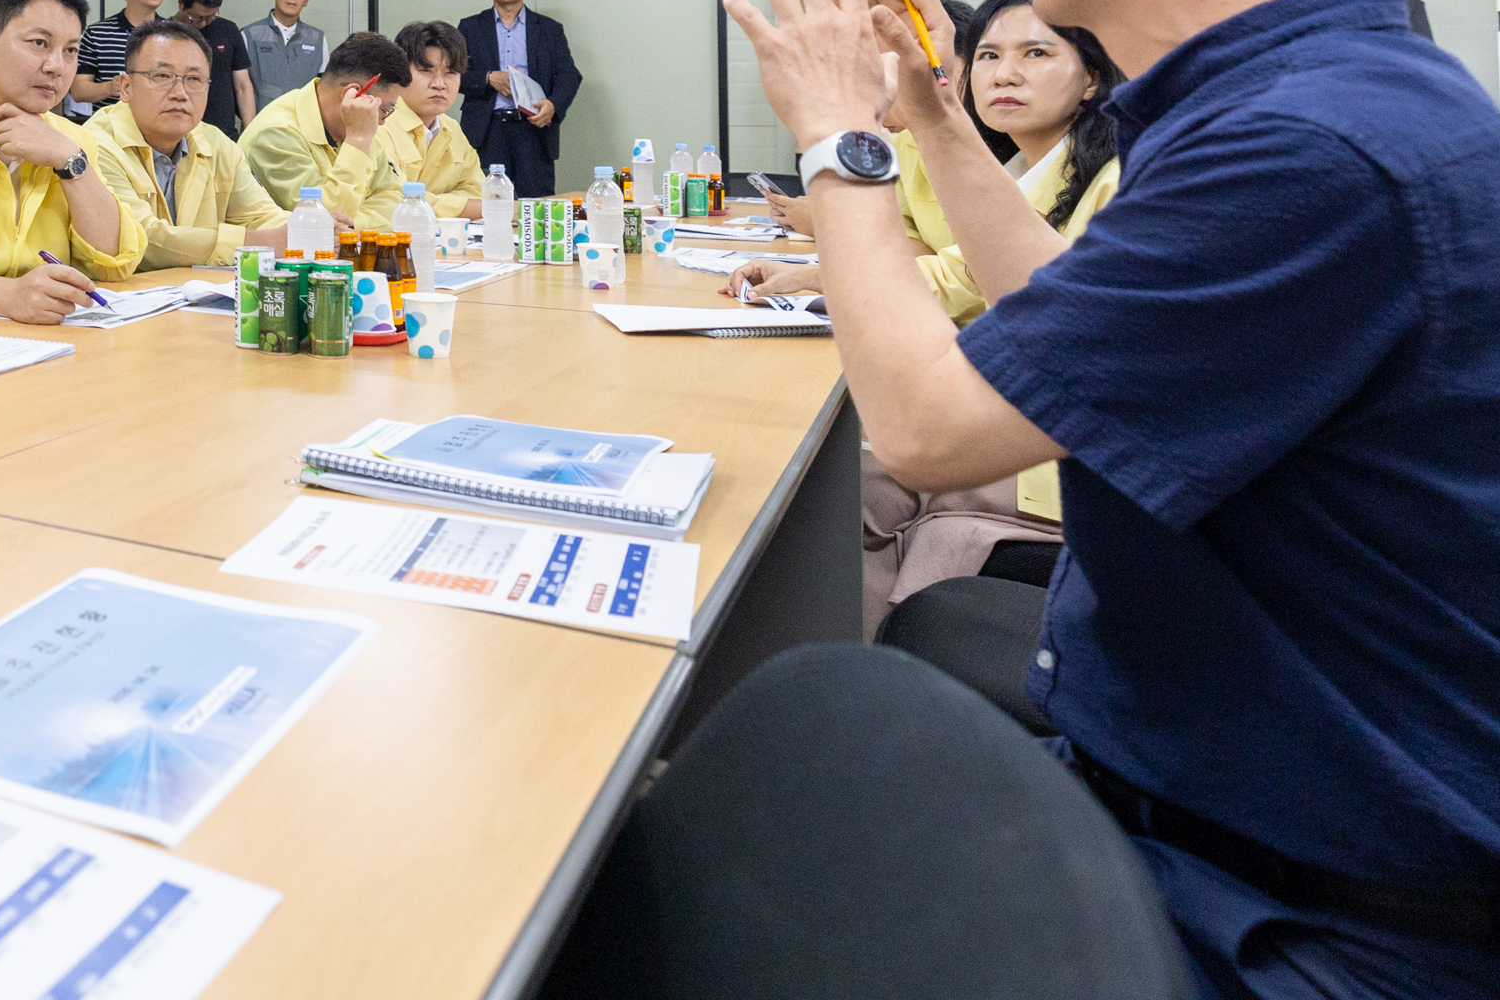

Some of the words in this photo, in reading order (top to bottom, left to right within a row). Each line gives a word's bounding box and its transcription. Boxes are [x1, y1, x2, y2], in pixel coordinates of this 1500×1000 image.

[523, 204, 531, 253] DEMISODA
[263, 290, 286, 305] 초록
[263, 303, 285, 318] 매실
